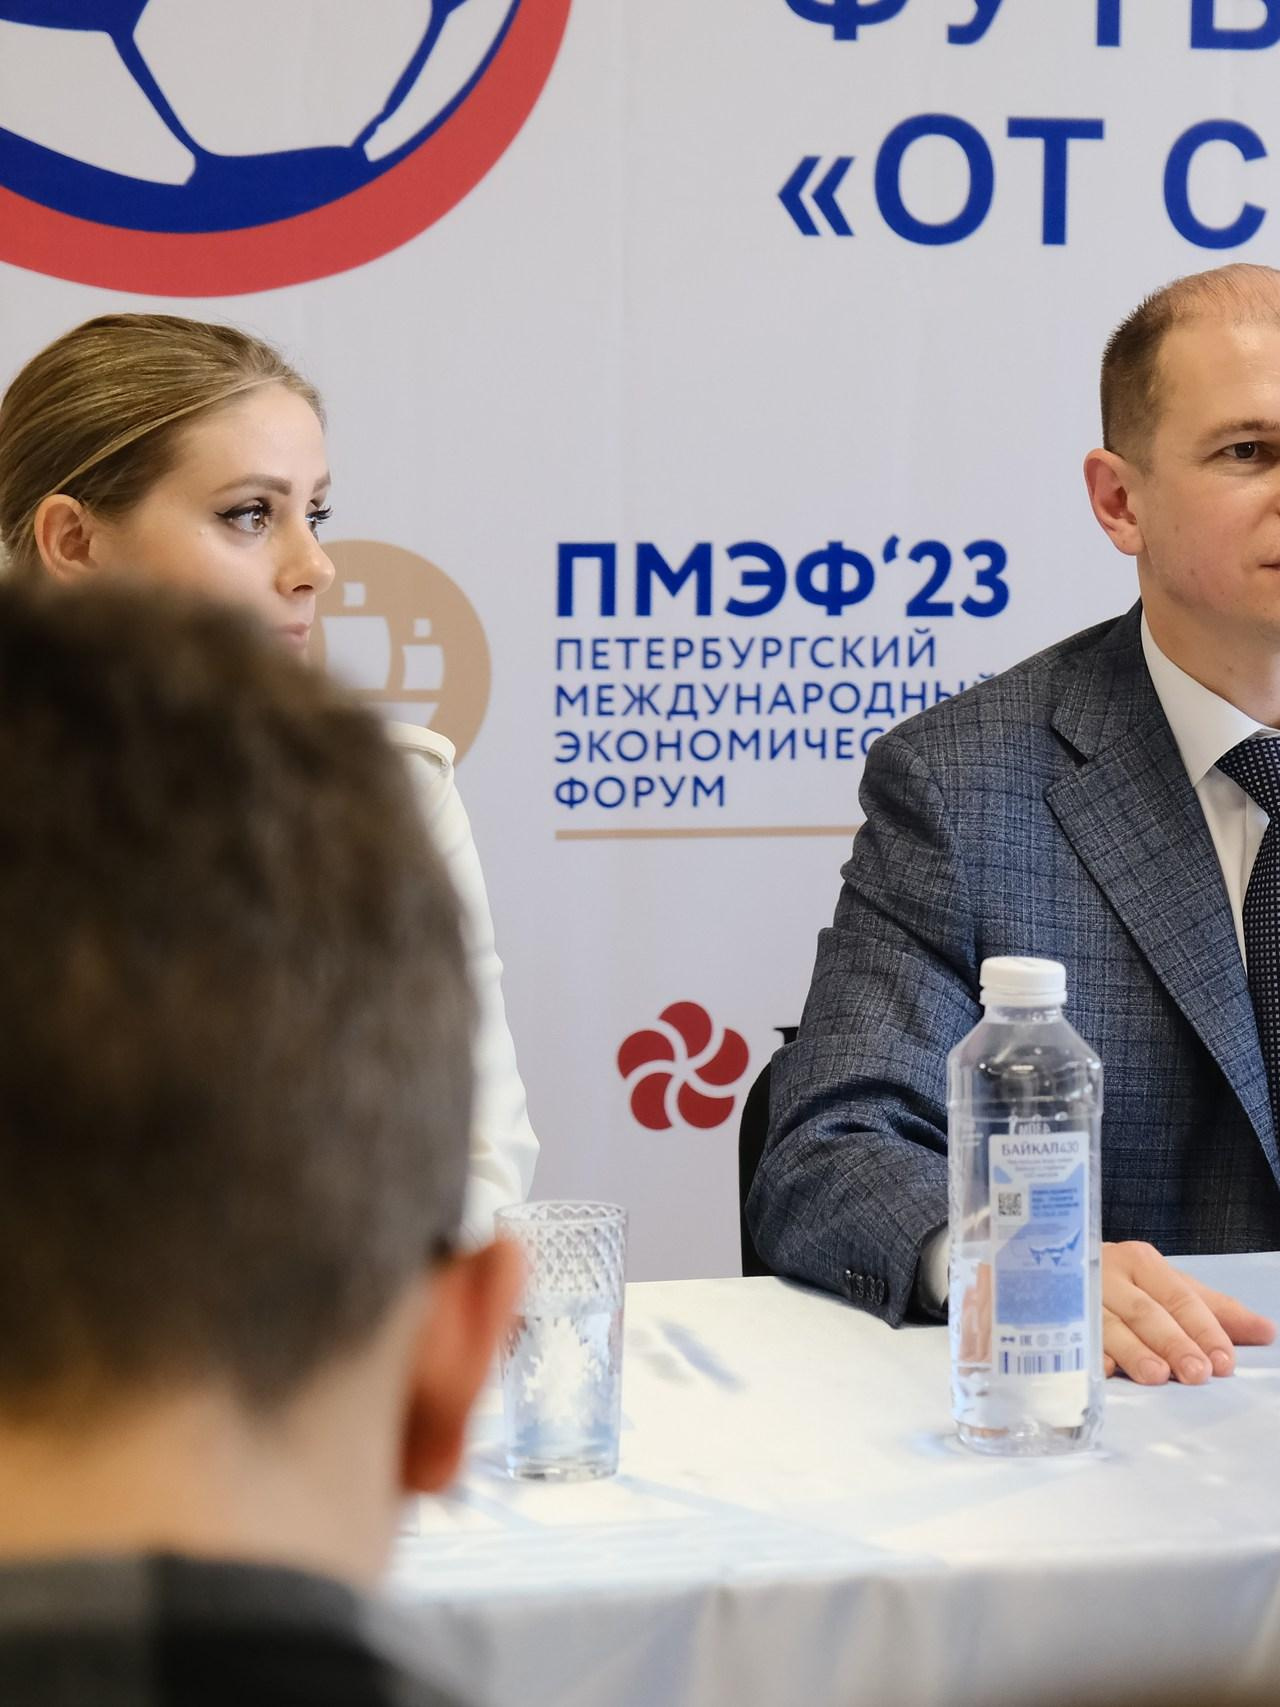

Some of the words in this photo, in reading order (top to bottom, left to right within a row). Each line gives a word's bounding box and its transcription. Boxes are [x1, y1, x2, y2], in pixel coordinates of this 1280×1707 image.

[779, 115, 1105, 247] «ОТ
[556, 628, 937, 671] ПЕТЕРБУРГСКИЙ
[556, 673, 997, 721] МЕЖДУНАРОДНЫ
[554, 774, 726, 810] ФОРУМ
